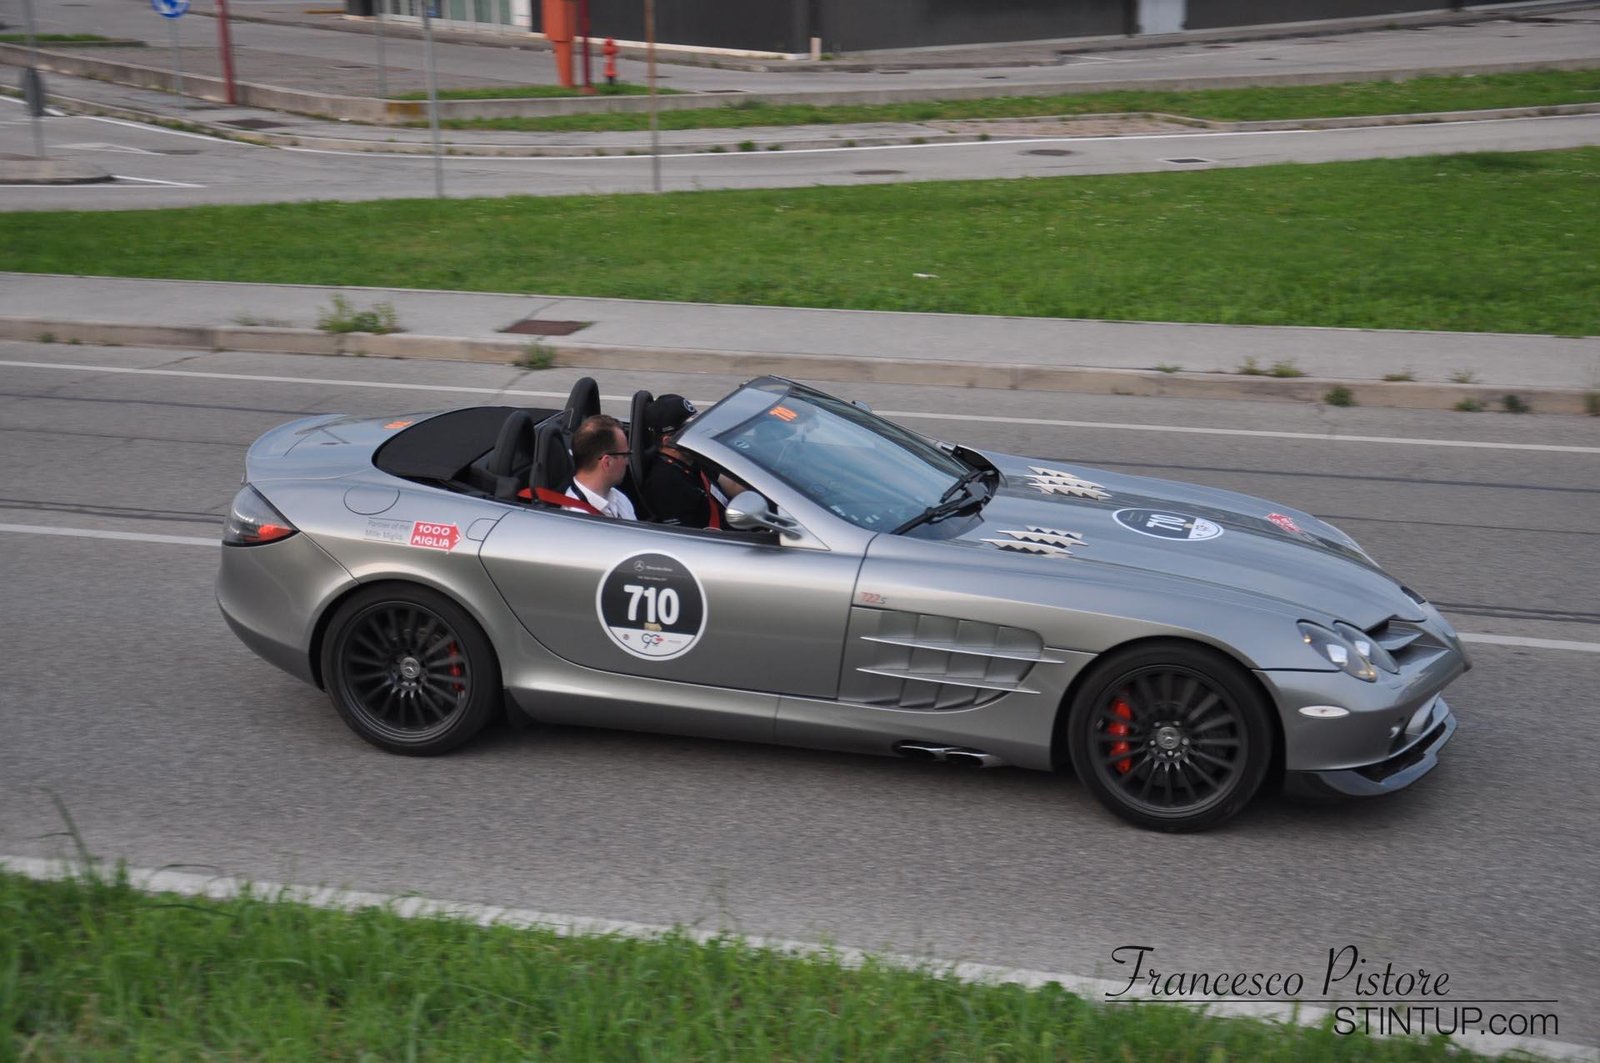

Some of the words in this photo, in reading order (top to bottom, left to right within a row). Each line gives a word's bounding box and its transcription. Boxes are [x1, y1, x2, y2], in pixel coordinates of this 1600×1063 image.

[418, 524, 450, 536] 1000
[1145, 514, 1186, 532] 710
[412, 535, 450, 548] MIGLIA
[623, 584, 680, 625] 710
